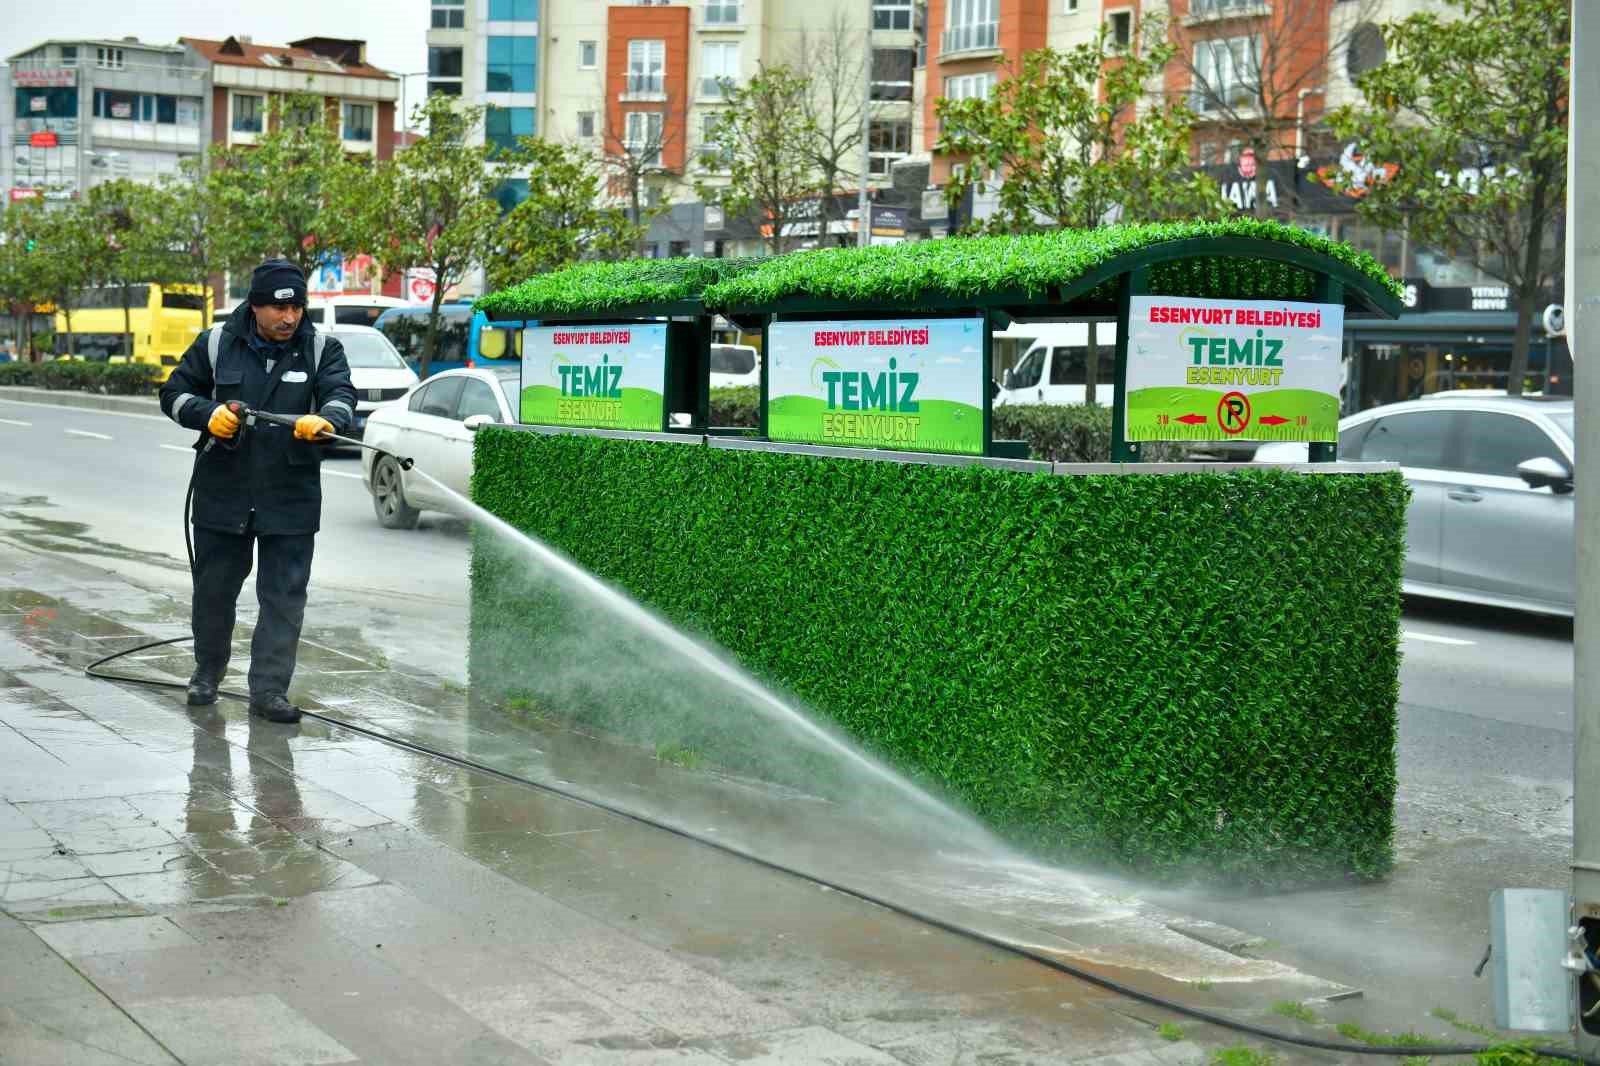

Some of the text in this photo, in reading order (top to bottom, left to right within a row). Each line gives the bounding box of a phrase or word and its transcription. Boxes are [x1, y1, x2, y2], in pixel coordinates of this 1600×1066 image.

[1150, 307, 1321, 328] ESENYURT BELEDİYESİ
[553, 328, 631, 345] ESENYURT BELEDİYESİ
[815, 325, 928, 346] ESENYURT BELEDİYESİ
[1188, 329, 1283, 366] TEMİZ
[558, 353, 623, 398] TEMİZ
[822, 357, 920, 412] TEMİZ
[1186, 367, 1283, 385] ESENYURT
[557, 399, 623, 421] ESENYURT
[822, 413, 921, 442] ESENYURT
